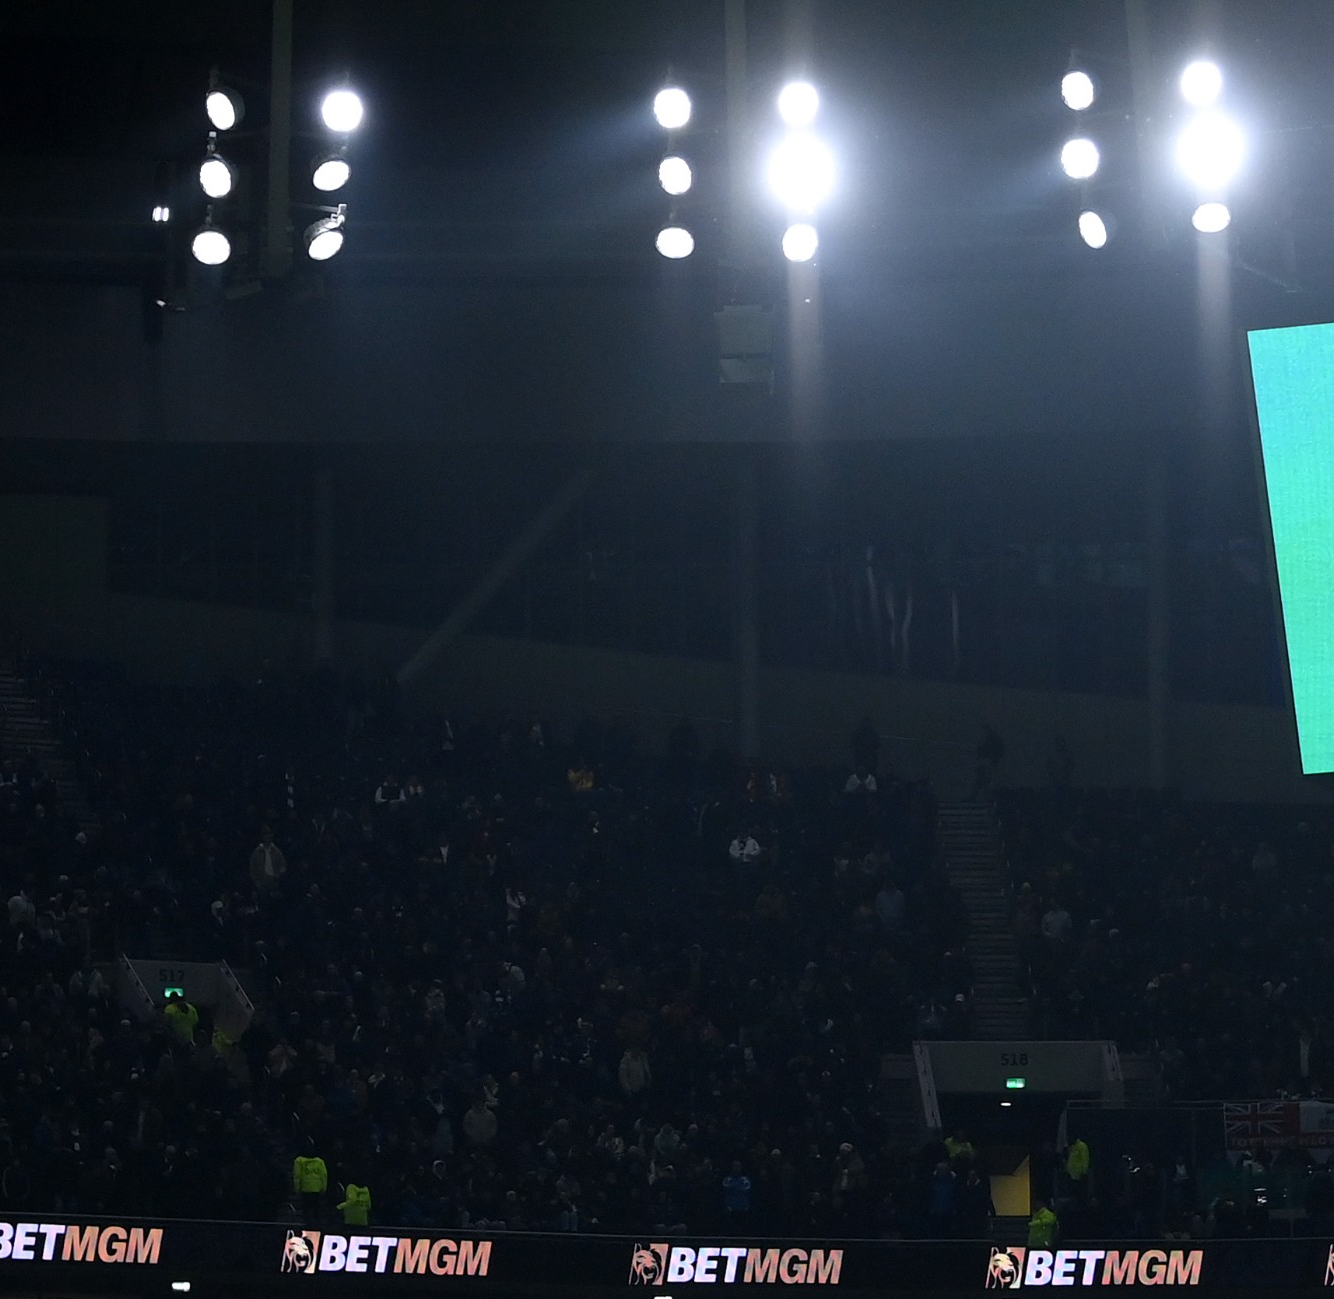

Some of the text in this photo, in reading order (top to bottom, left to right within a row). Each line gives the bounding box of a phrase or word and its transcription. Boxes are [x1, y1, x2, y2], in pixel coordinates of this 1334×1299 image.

[319, 1235, 491, 1275] BETMGM
[667, 1247, 843, 1283] BETMGM
[1025, 1250, 1203, 1285] BETMGM
